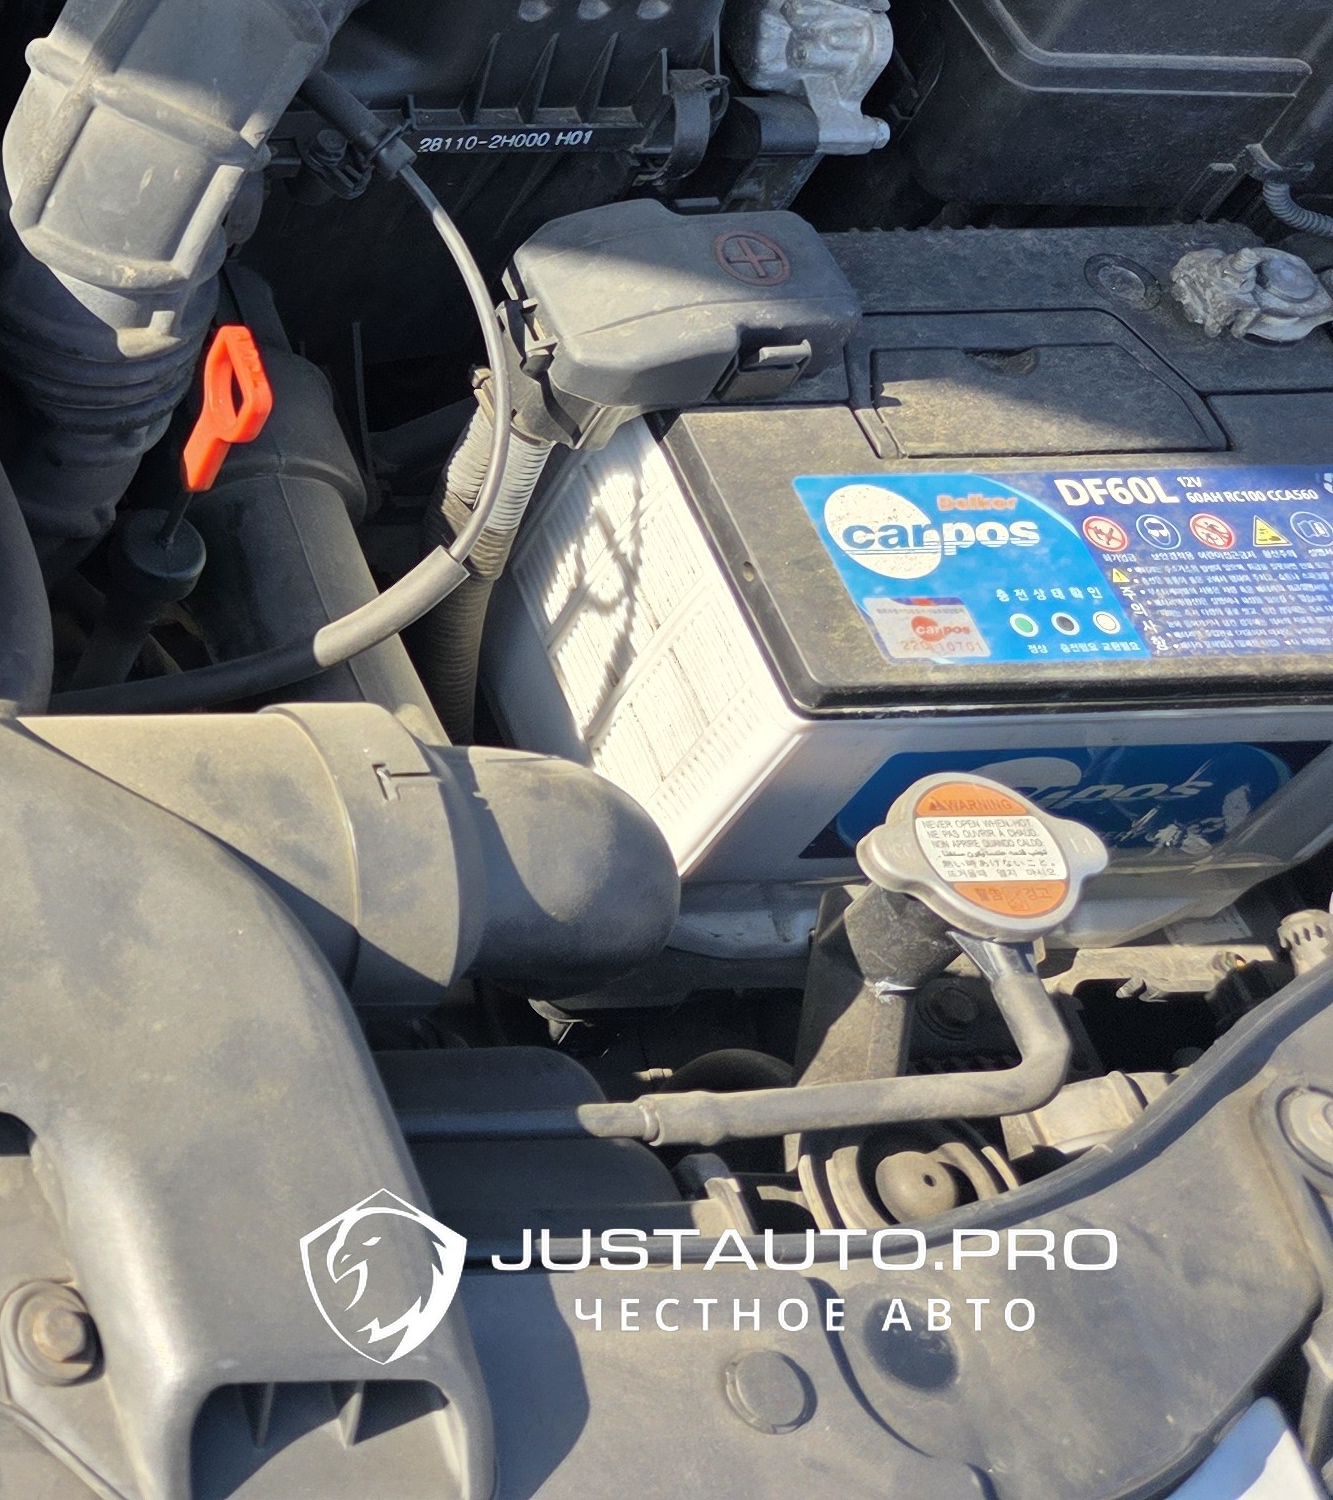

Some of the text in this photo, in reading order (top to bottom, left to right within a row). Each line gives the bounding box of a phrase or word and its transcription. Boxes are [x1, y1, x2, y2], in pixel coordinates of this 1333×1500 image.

[418, 130, 594, 152] 28110-2H000 H01
[1054, 476, 1202, 507] DF60L 12V
[1185, 489, 1319, 504] 60AH RC100 CCA560
[841, 519, 1041, 555] carpos
[945, 799, 1013, 812] WARNING
[922, 818, 952, 829] NEVER
[955, 818, 981, 828] OPEN
[982, 818, 1009, 828] WHEN
[932, 839, 949, 849] NON
